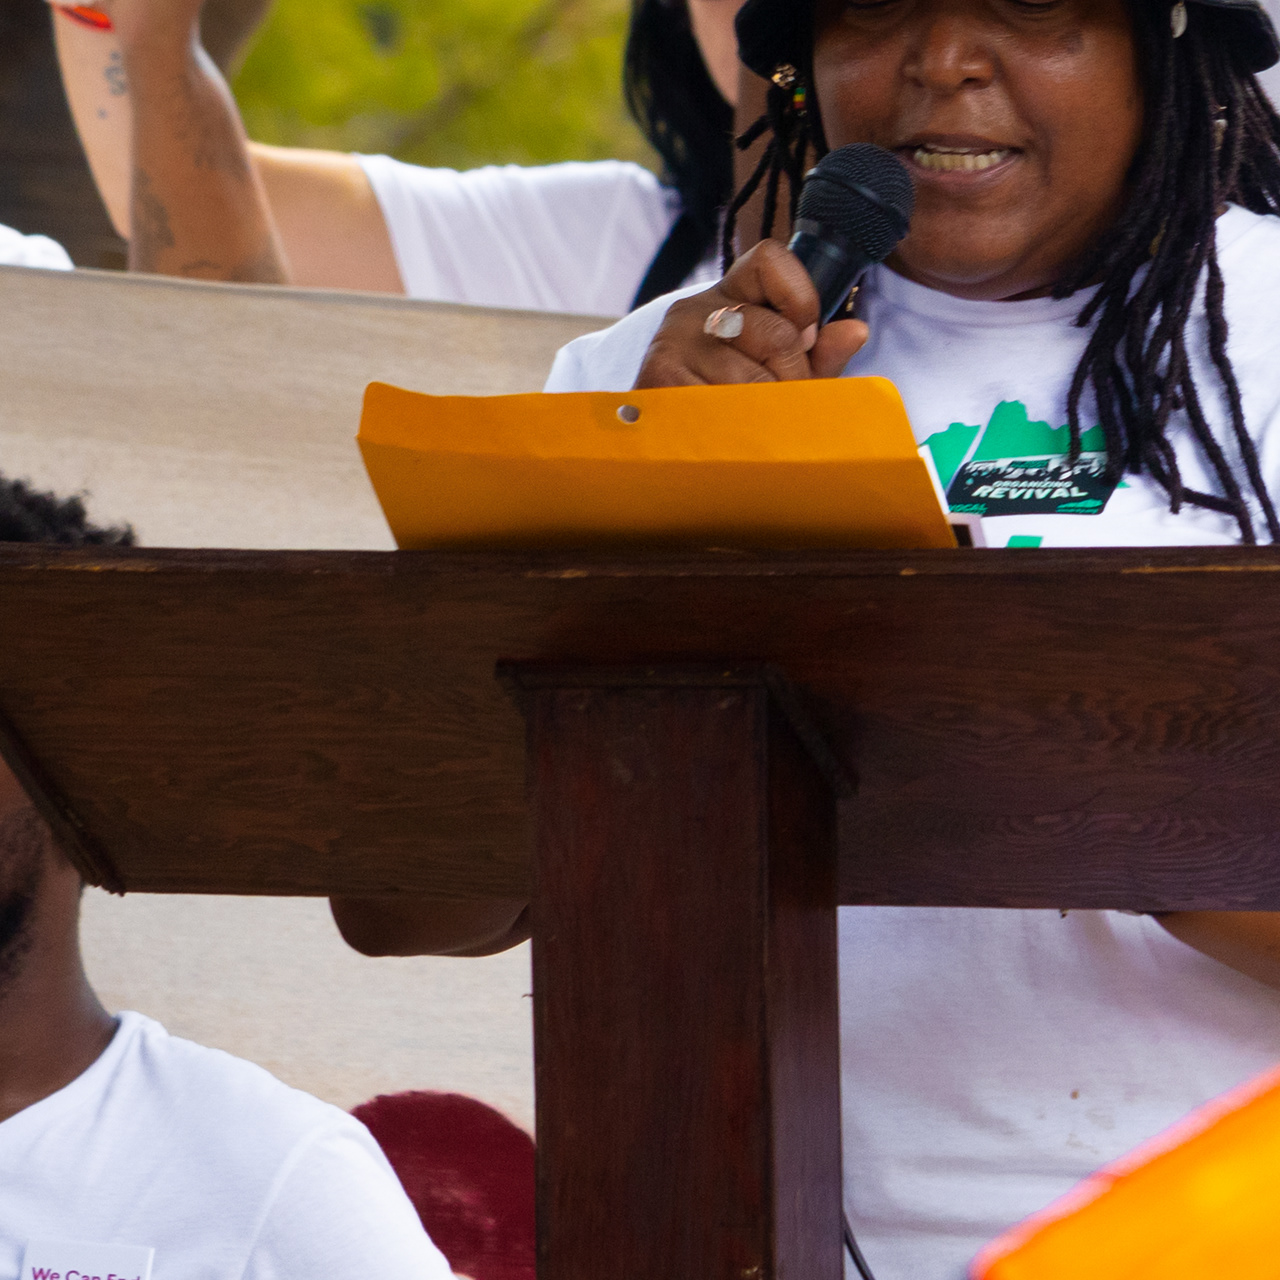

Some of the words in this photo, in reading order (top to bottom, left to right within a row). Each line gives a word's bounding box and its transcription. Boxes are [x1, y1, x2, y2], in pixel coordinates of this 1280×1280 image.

[991, 479, 1074, 489] ORGANIZING
[971, 485, 1089, 500] REVIVAL
[32, 1267, 60, 1280] We
